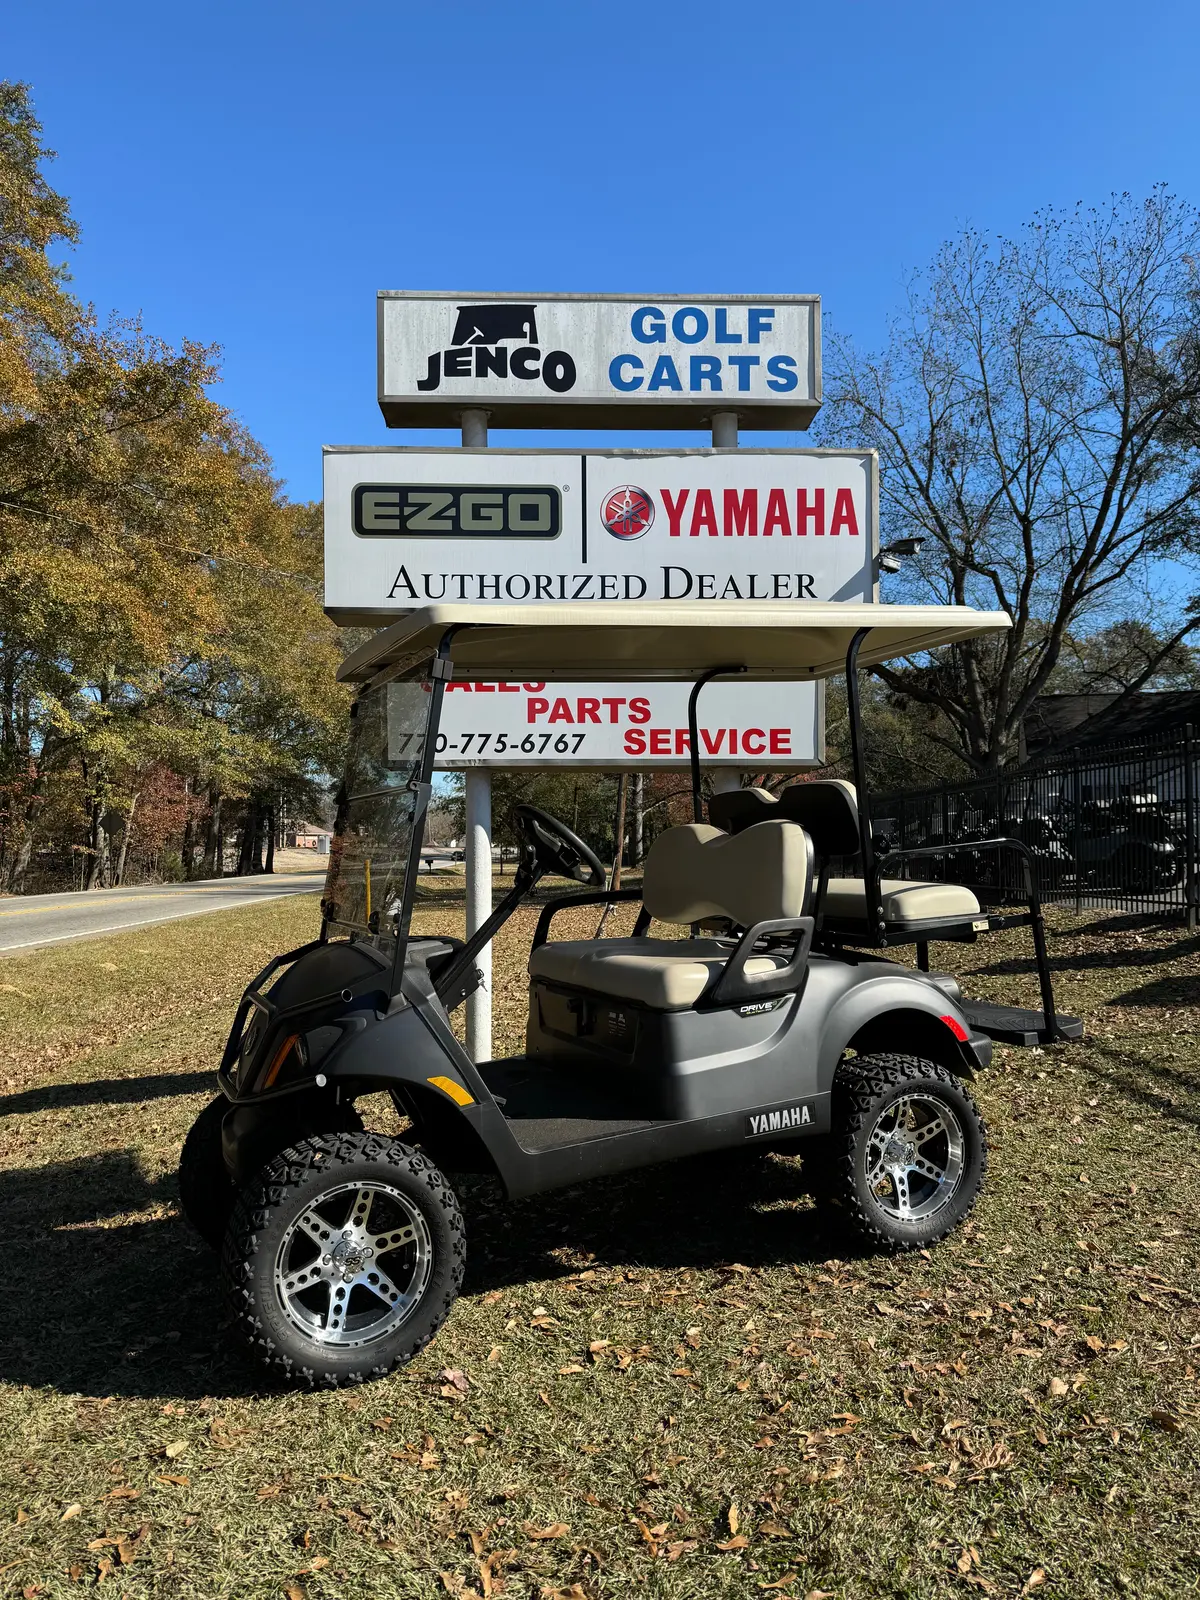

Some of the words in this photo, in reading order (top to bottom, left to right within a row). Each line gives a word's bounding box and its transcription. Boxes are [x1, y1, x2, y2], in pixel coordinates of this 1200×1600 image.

[631, 306, 775, 345] GOLF
[417, 346, 577, 393] JENCO
[608, 354, 799, 393] CARTS
[660, 488, 859, 537] YAMAHA
[386, 565, 647, 600] AUTHORIZED
[660, 566, 819, 600] DEALER
[527, 697, 651, 725] PARTS
[623, 728, 792, 755] SERVICE
[749, 1105, 811, 1134] YAMAHA
